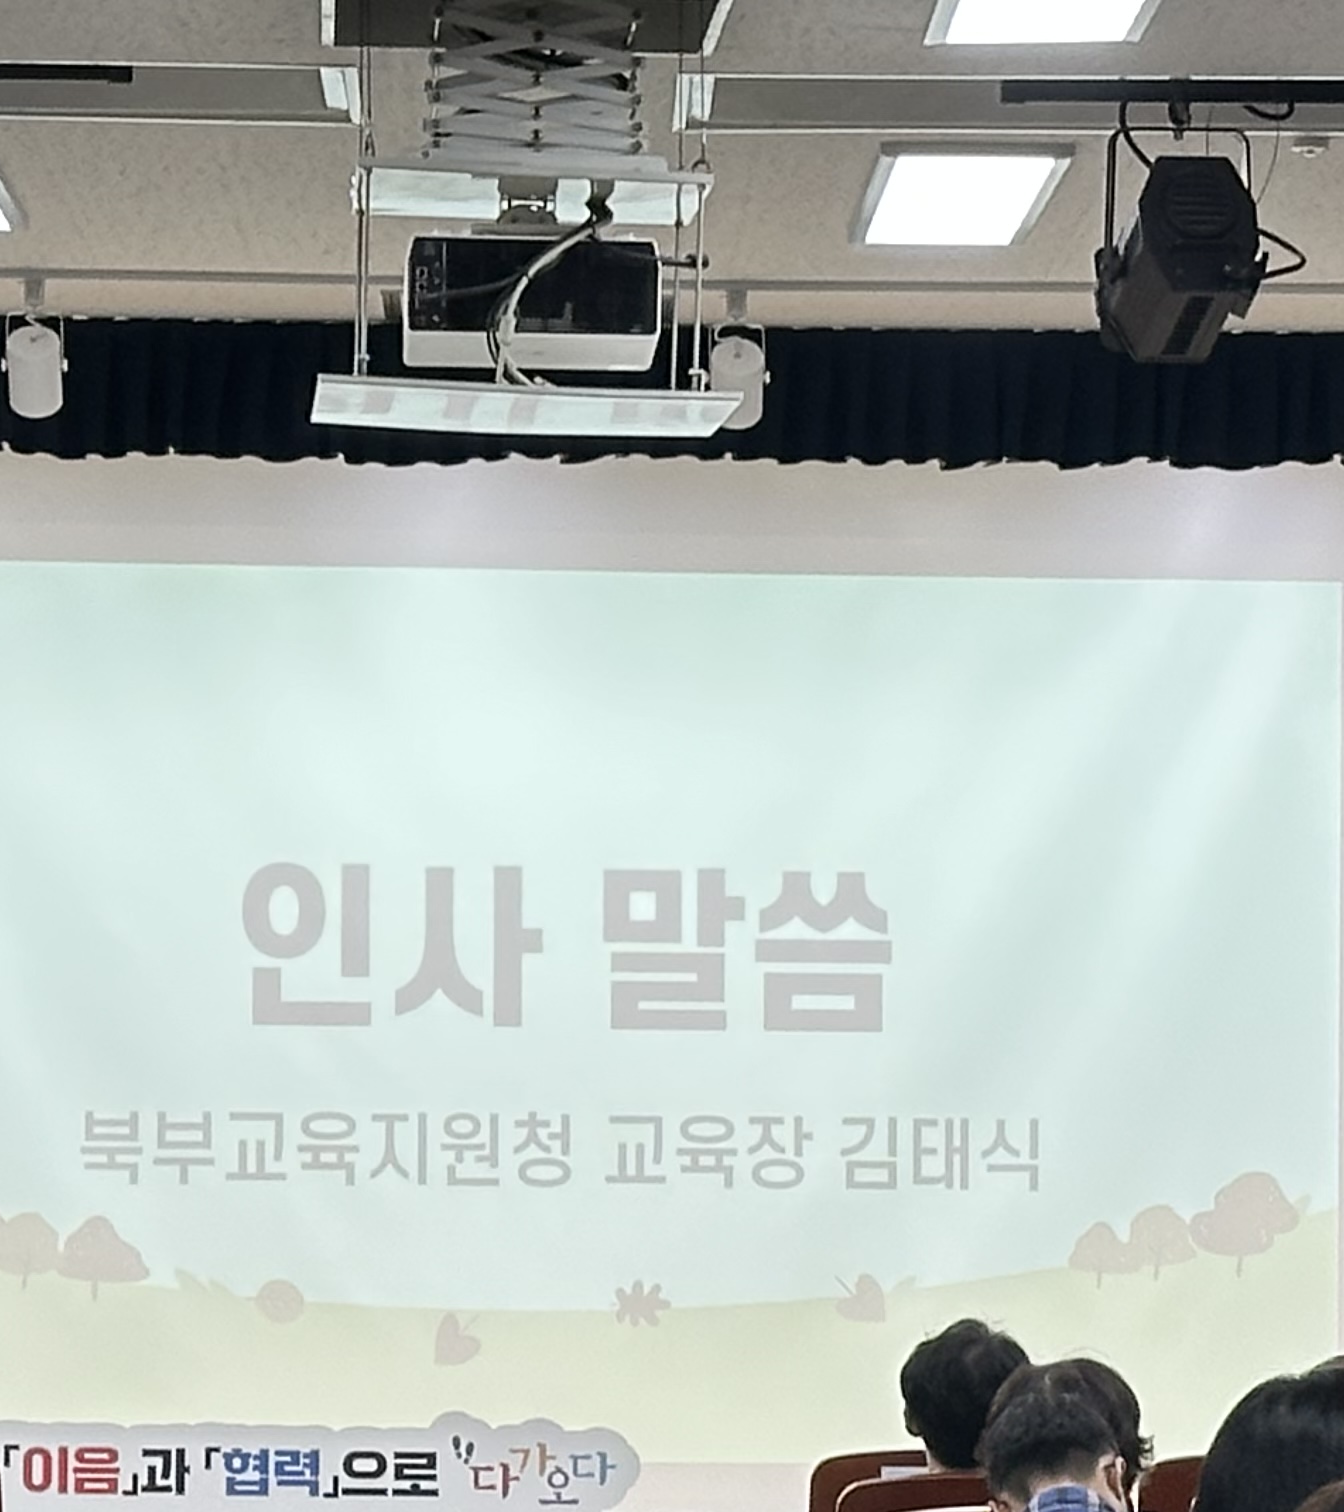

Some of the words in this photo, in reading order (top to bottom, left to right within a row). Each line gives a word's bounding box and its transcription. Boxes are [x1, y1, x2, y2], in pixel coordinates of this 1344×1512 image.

[241, 861, 544, 1027] 인사
[602, 867, 893, 1033] 말씀
[80, 1110, 574, 1188] 북부교육지원청
[605, 1114, 814, 1190] 교육장
[839, 1117, 1040, 1192] 김태식
